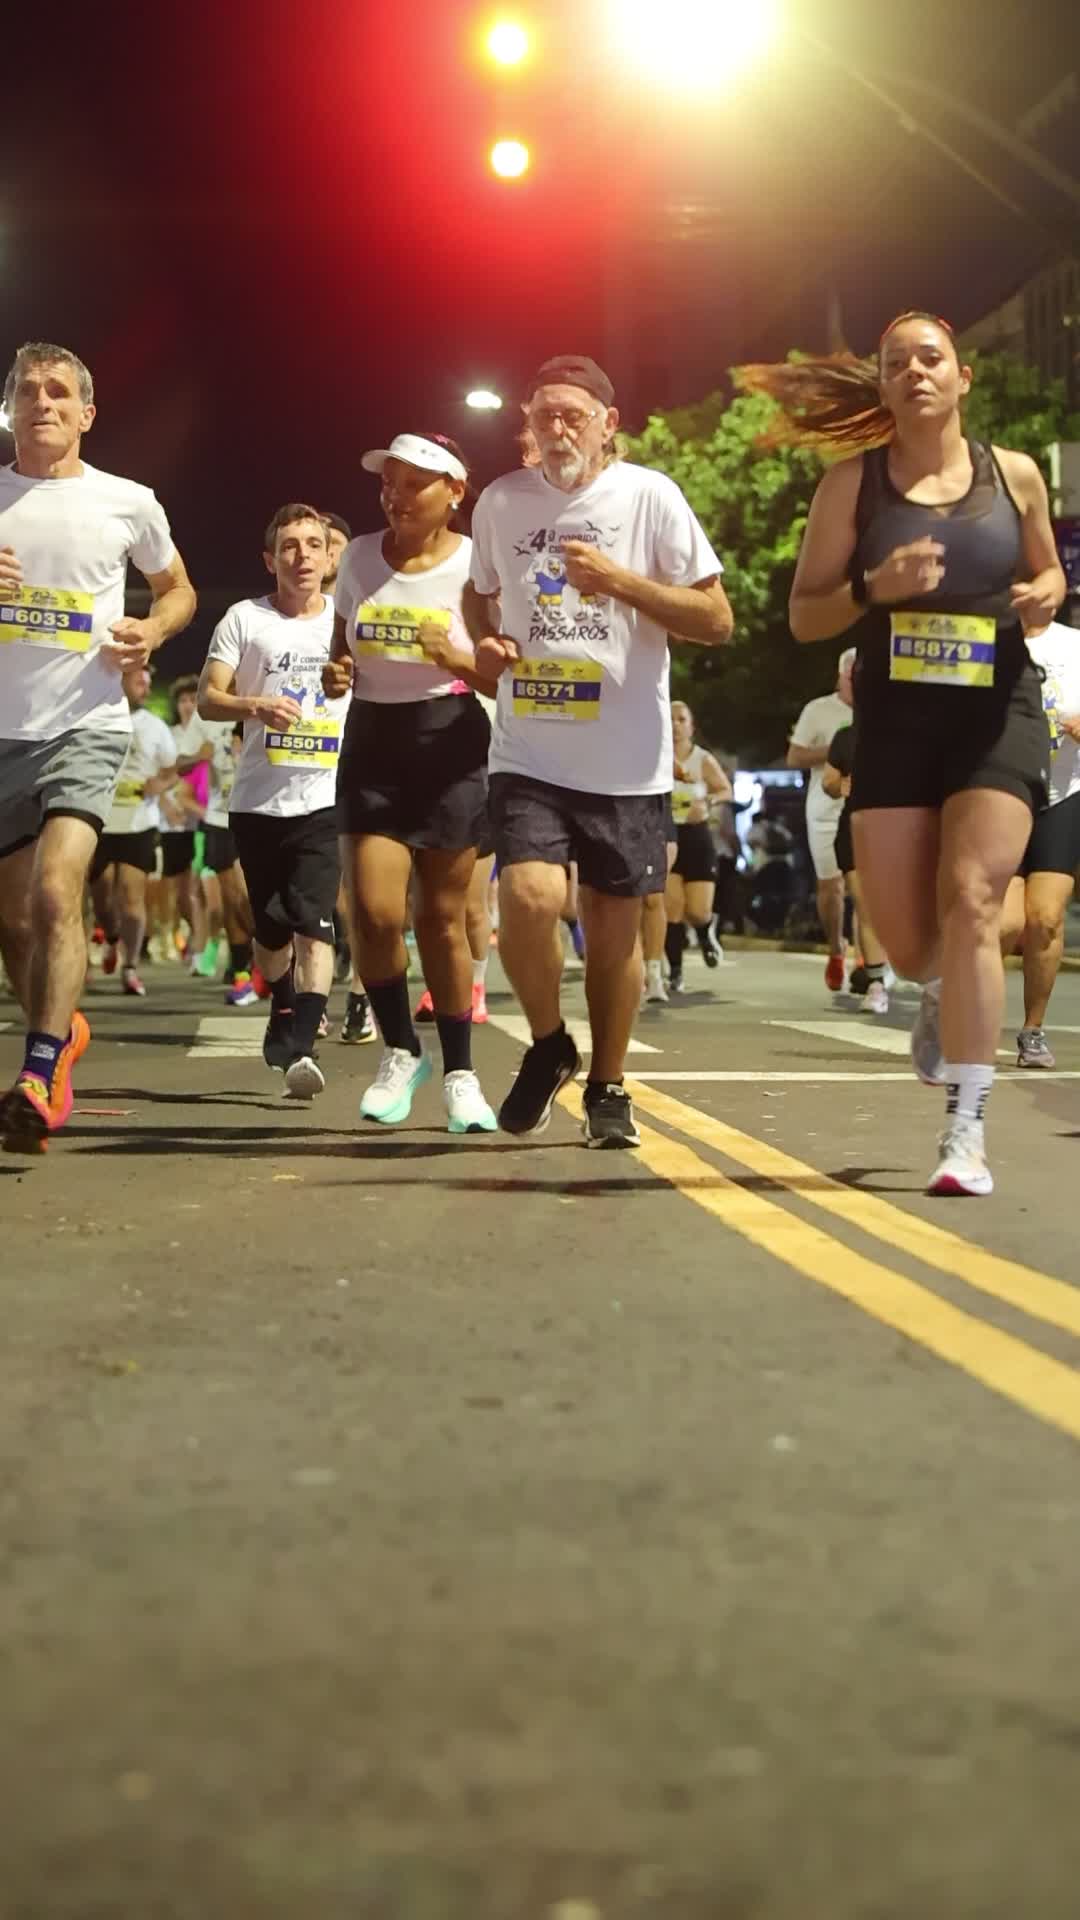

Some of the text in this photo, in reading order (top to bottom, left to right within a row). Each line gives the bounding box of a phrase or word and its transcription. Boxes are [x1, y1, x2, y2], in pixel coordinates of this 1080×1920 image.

[15, 609, 70, 628] 6033
[374, 625, 417, 641] 538
[914, 639, 972, 660] 5879
[526, 683, 576, 698] 6371
[282, 736, 323, 750] 5501
